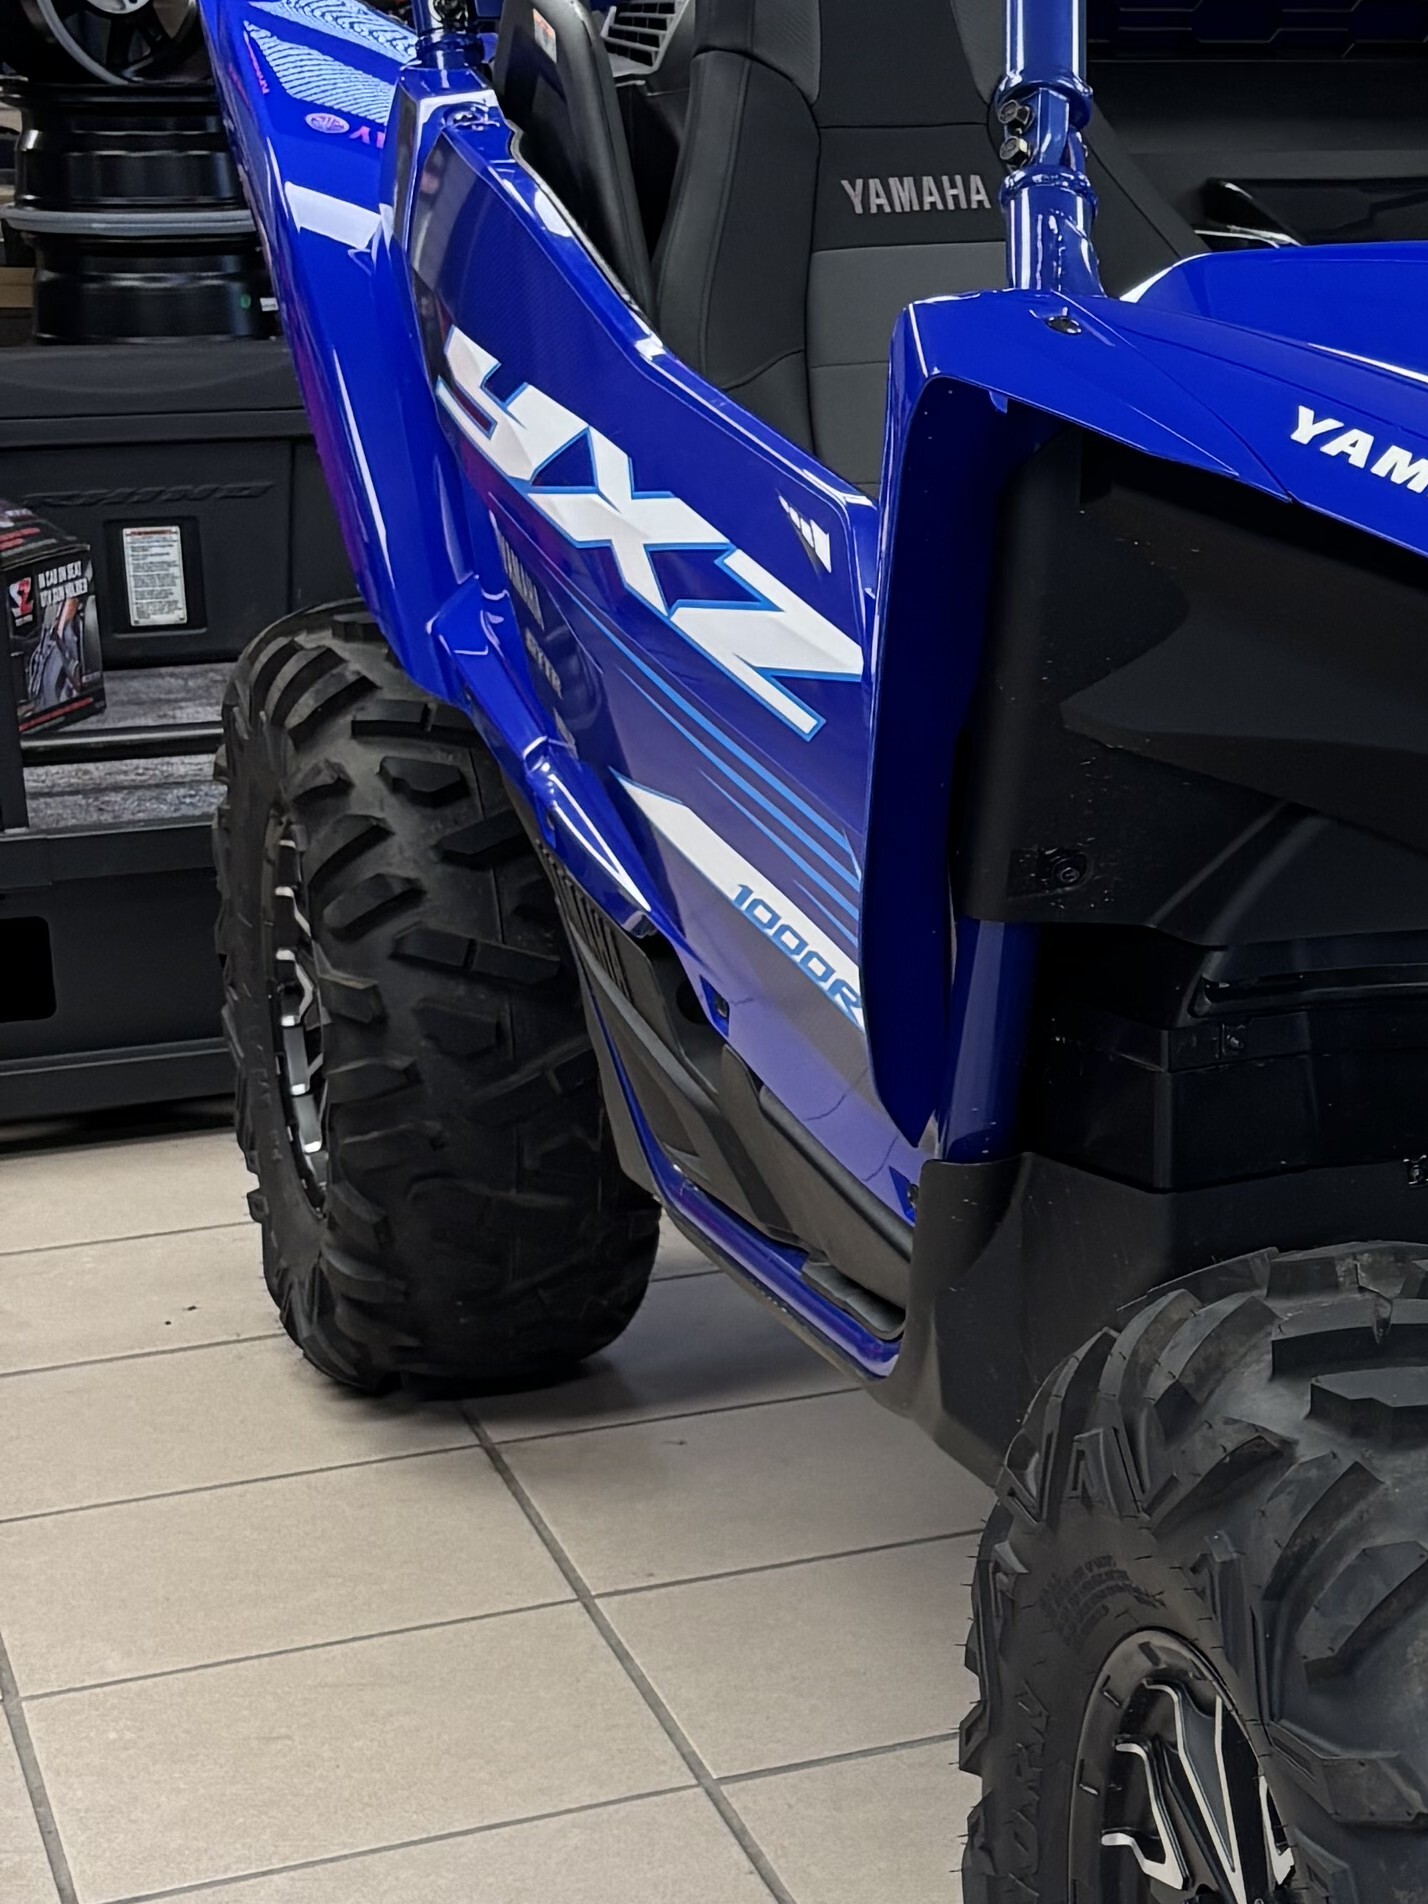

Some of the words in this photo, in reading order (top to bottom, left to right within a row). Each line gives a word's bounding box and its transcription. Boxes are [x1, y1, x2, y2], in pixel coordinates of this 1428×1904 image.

[840, 174, 992, 215] YAMAHA
[435, 324, 864, 741] YXZ
[731, 883, 862, 1029] 1000R
